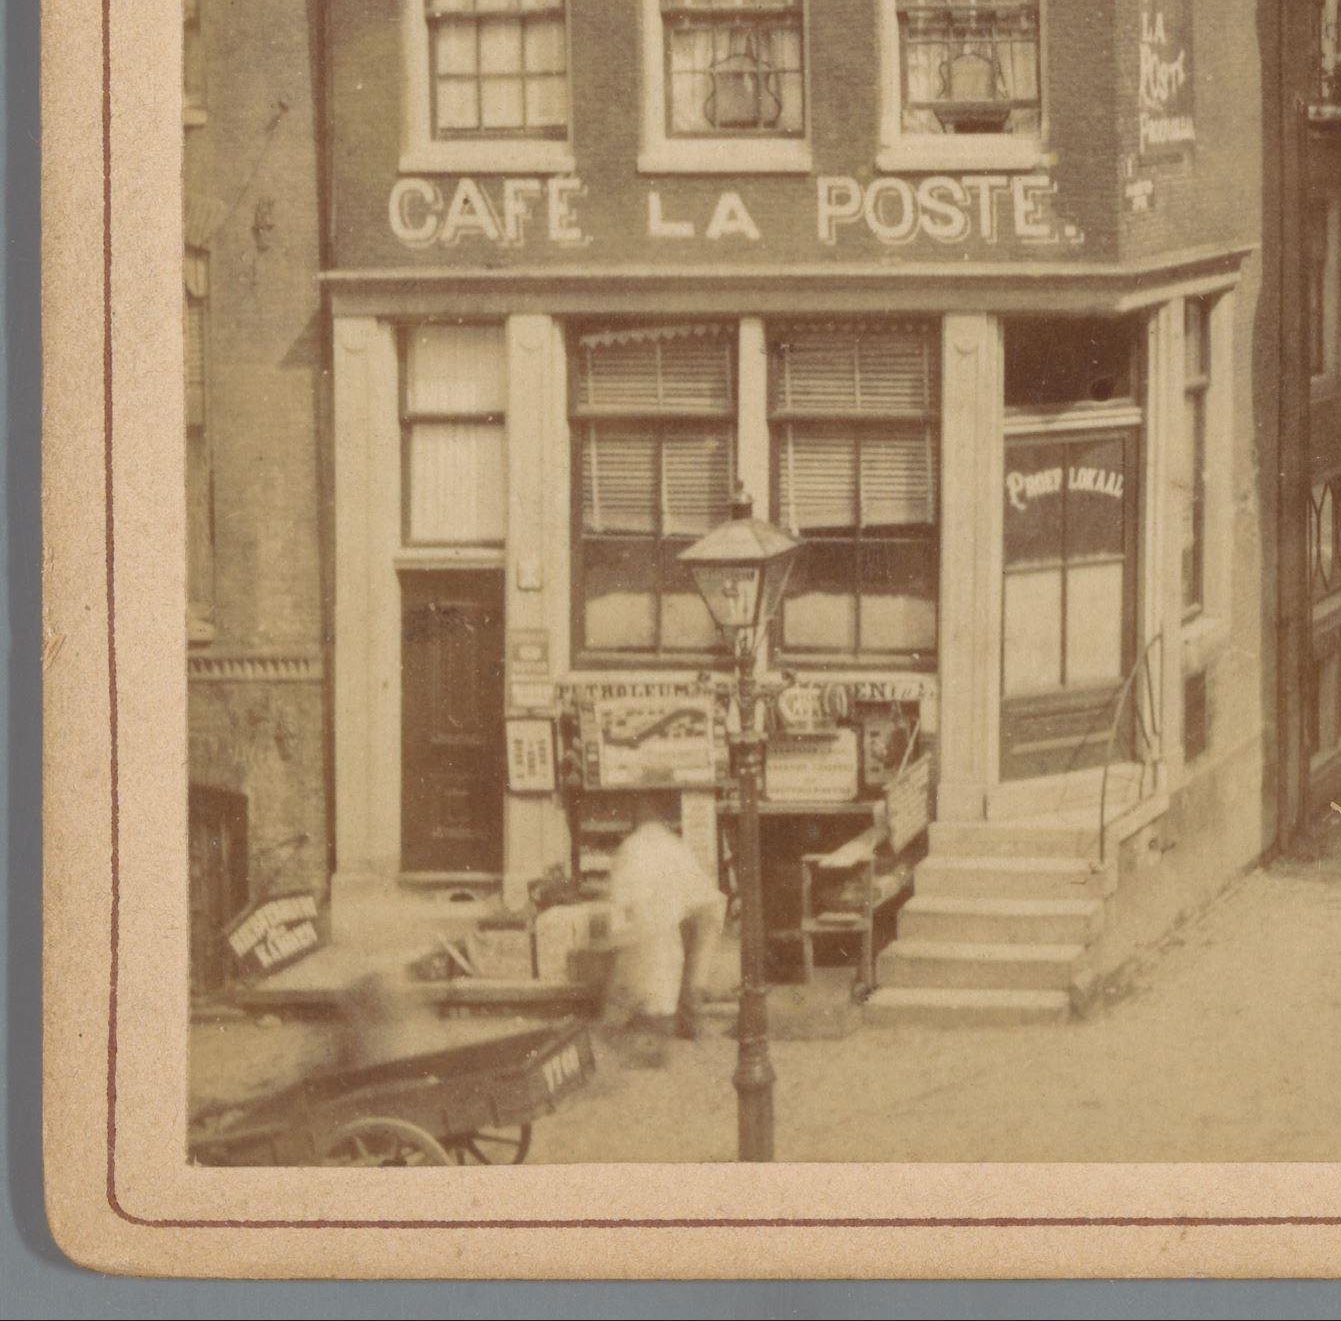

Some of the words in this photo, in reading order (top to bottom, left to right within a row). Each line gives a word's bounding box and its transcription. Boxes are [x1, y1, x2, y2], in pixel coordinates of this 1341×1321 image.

[648, 190, 760, 239] LA
[816, 174, 1085, 246] POSTE.
[1067, 466, 1124, 497] LOKAAL
